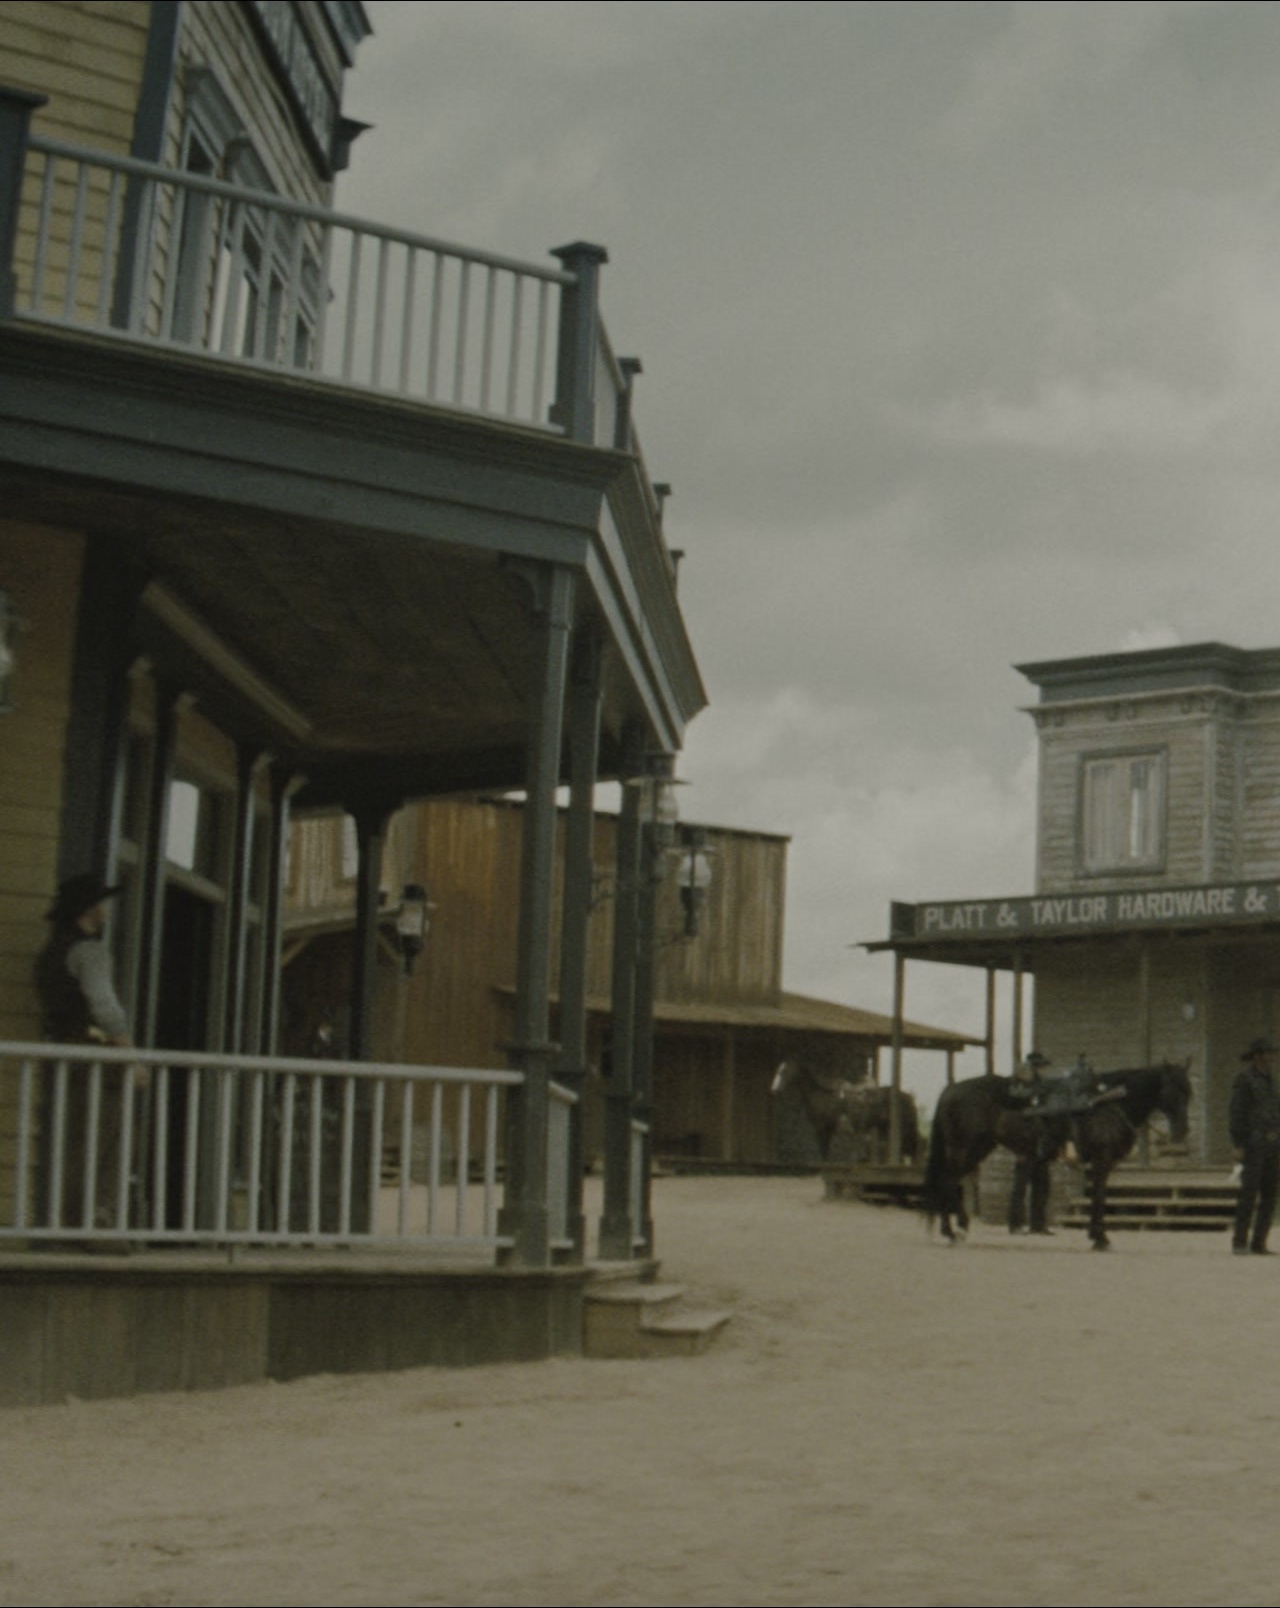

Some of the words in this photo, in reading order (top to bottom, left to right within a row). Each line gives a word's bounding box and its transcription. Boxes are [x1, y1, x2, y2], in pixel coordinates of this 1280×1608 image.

[924, 905, 986, 933] PLATT
[995, 902, 1018, 928] &
[1029, 896, 1106, 926] TAYLOR
[1117, 886, 1236, 921] HARDWARE
[1243, 885, 1268, 914] &
